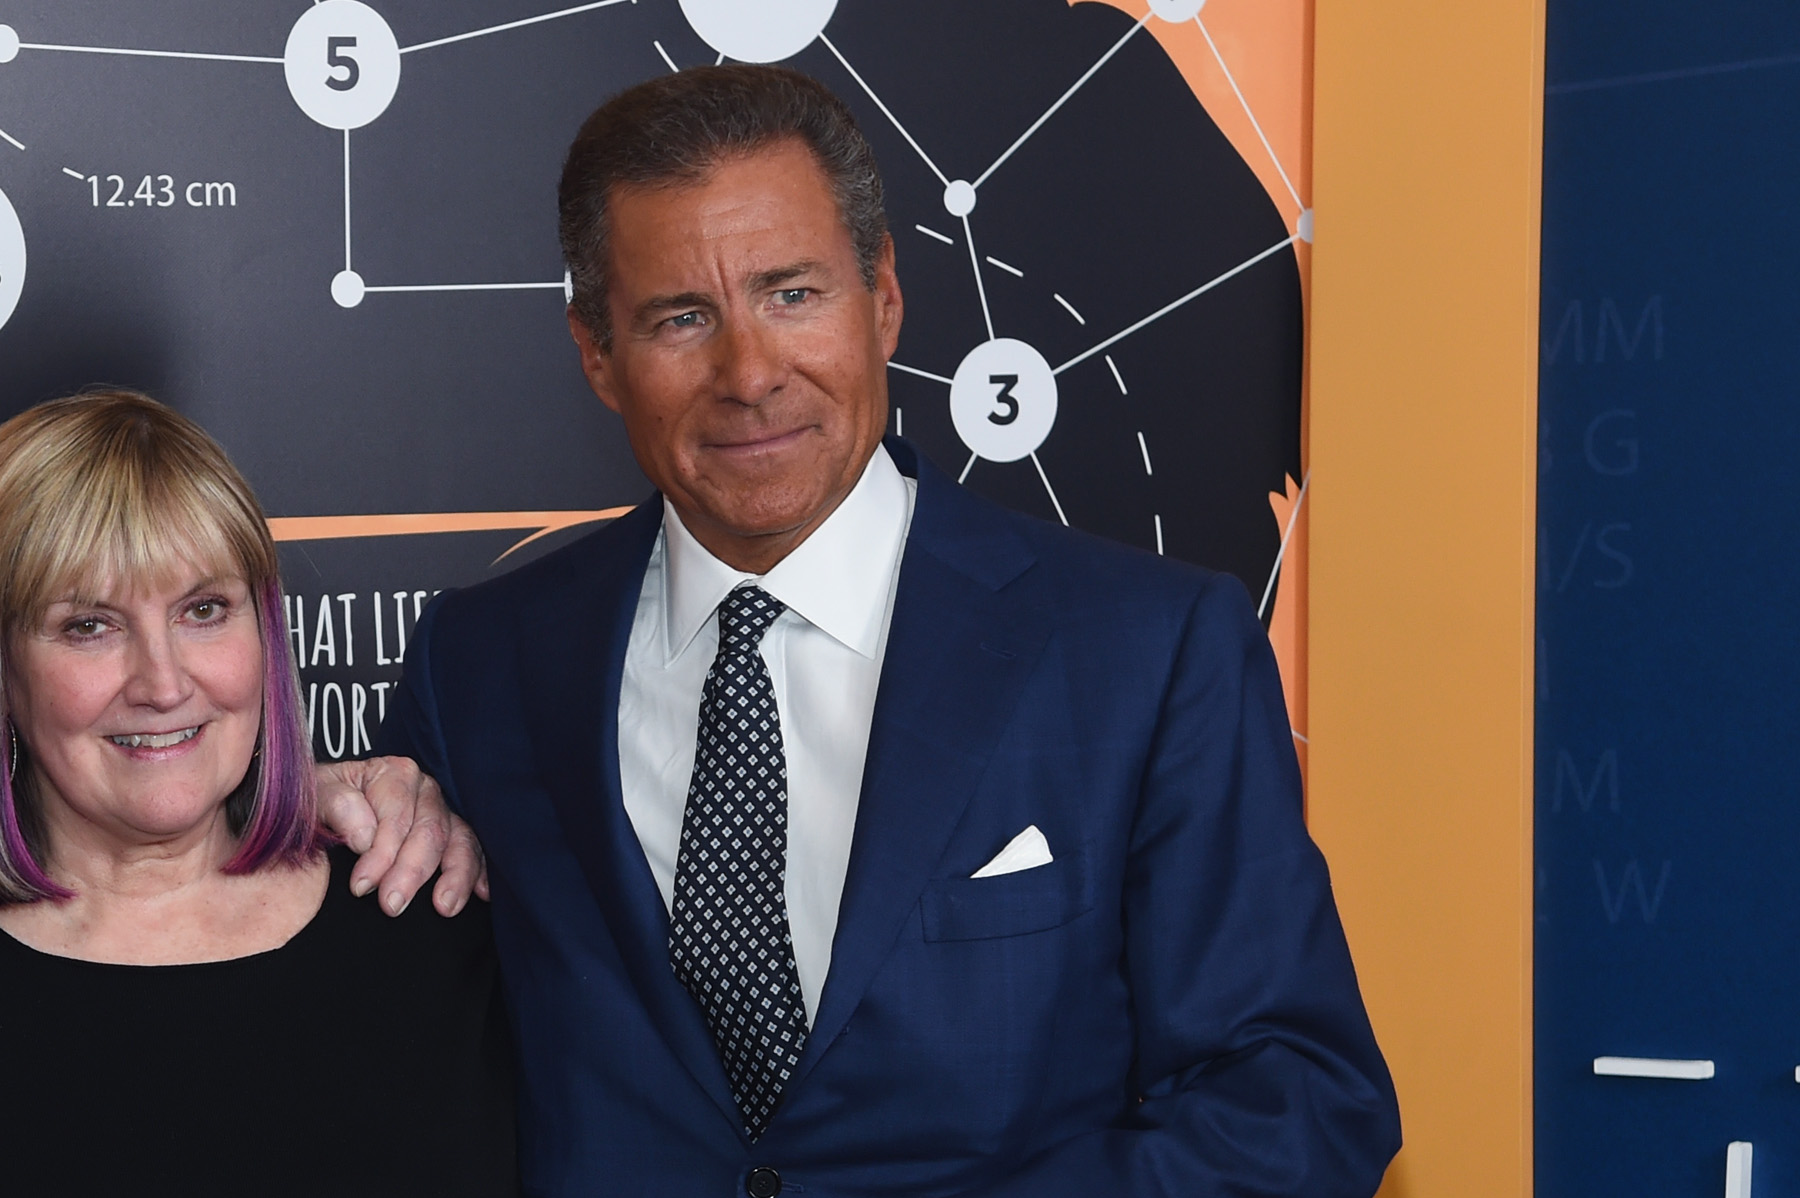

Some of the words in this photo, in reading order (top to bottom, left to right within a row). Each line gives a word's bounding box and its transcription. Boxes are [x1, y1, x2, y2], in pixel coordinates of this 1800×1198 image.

[324, 36, 361, 92] 5
[86, 174, 176, 207] 12.43
[185, 180, 237, 207] cm
[986, 373, 1020, 426] 3
